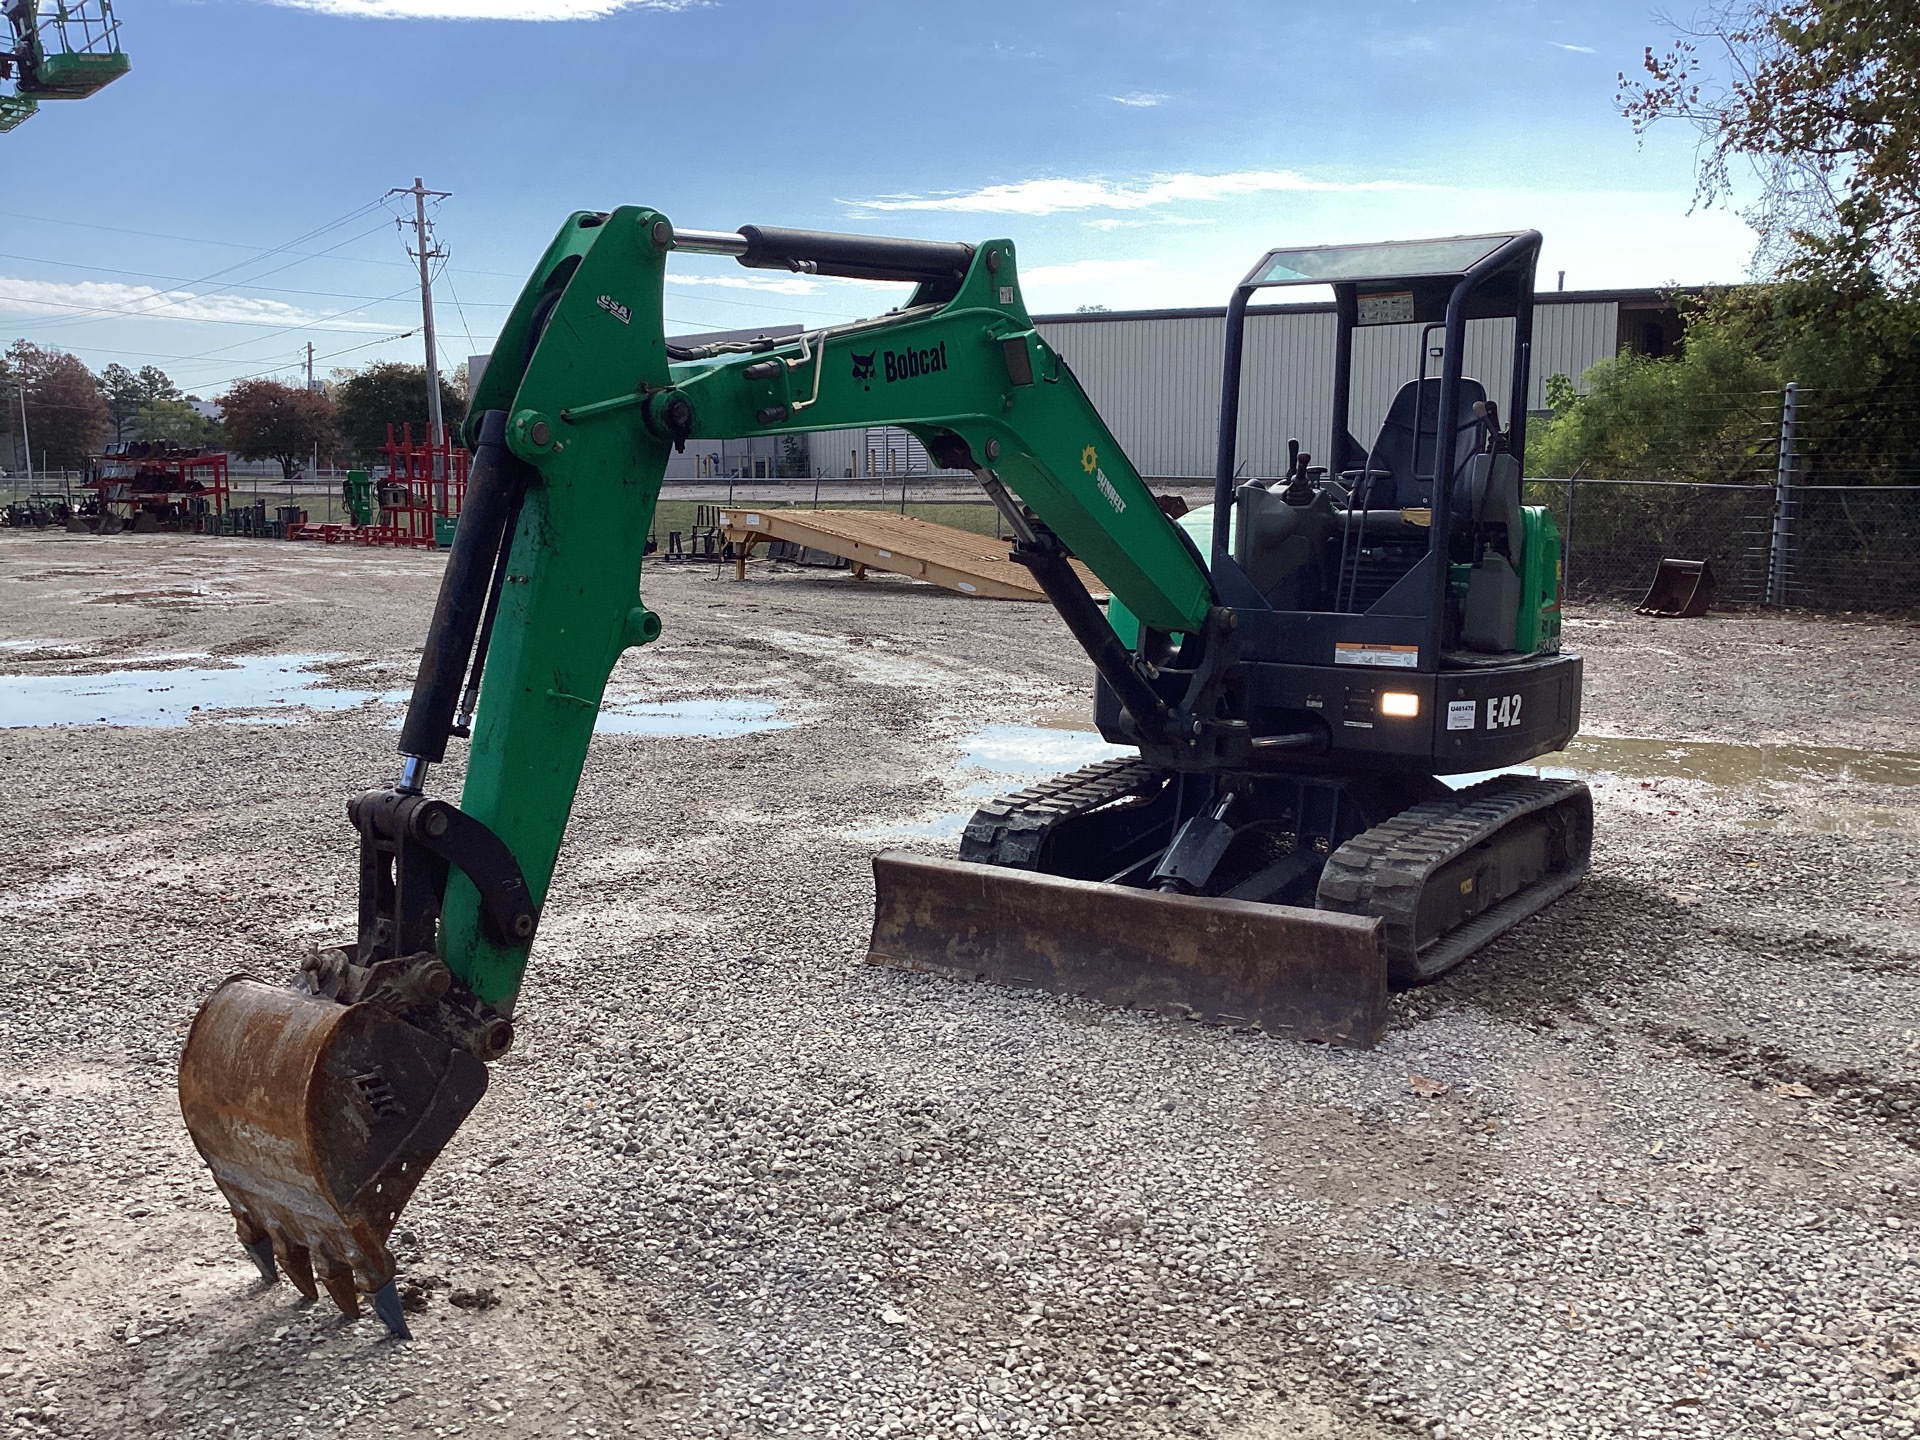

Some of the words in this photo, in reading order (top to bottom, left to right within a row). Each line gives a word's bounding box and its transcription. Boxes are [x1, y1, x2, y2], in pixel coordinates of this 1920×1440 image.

[883, 340, 948, 384] Bobcat
[1096, 467, 1127, 514] SUNBELT
[1486, 693, 1522, 730] E42
